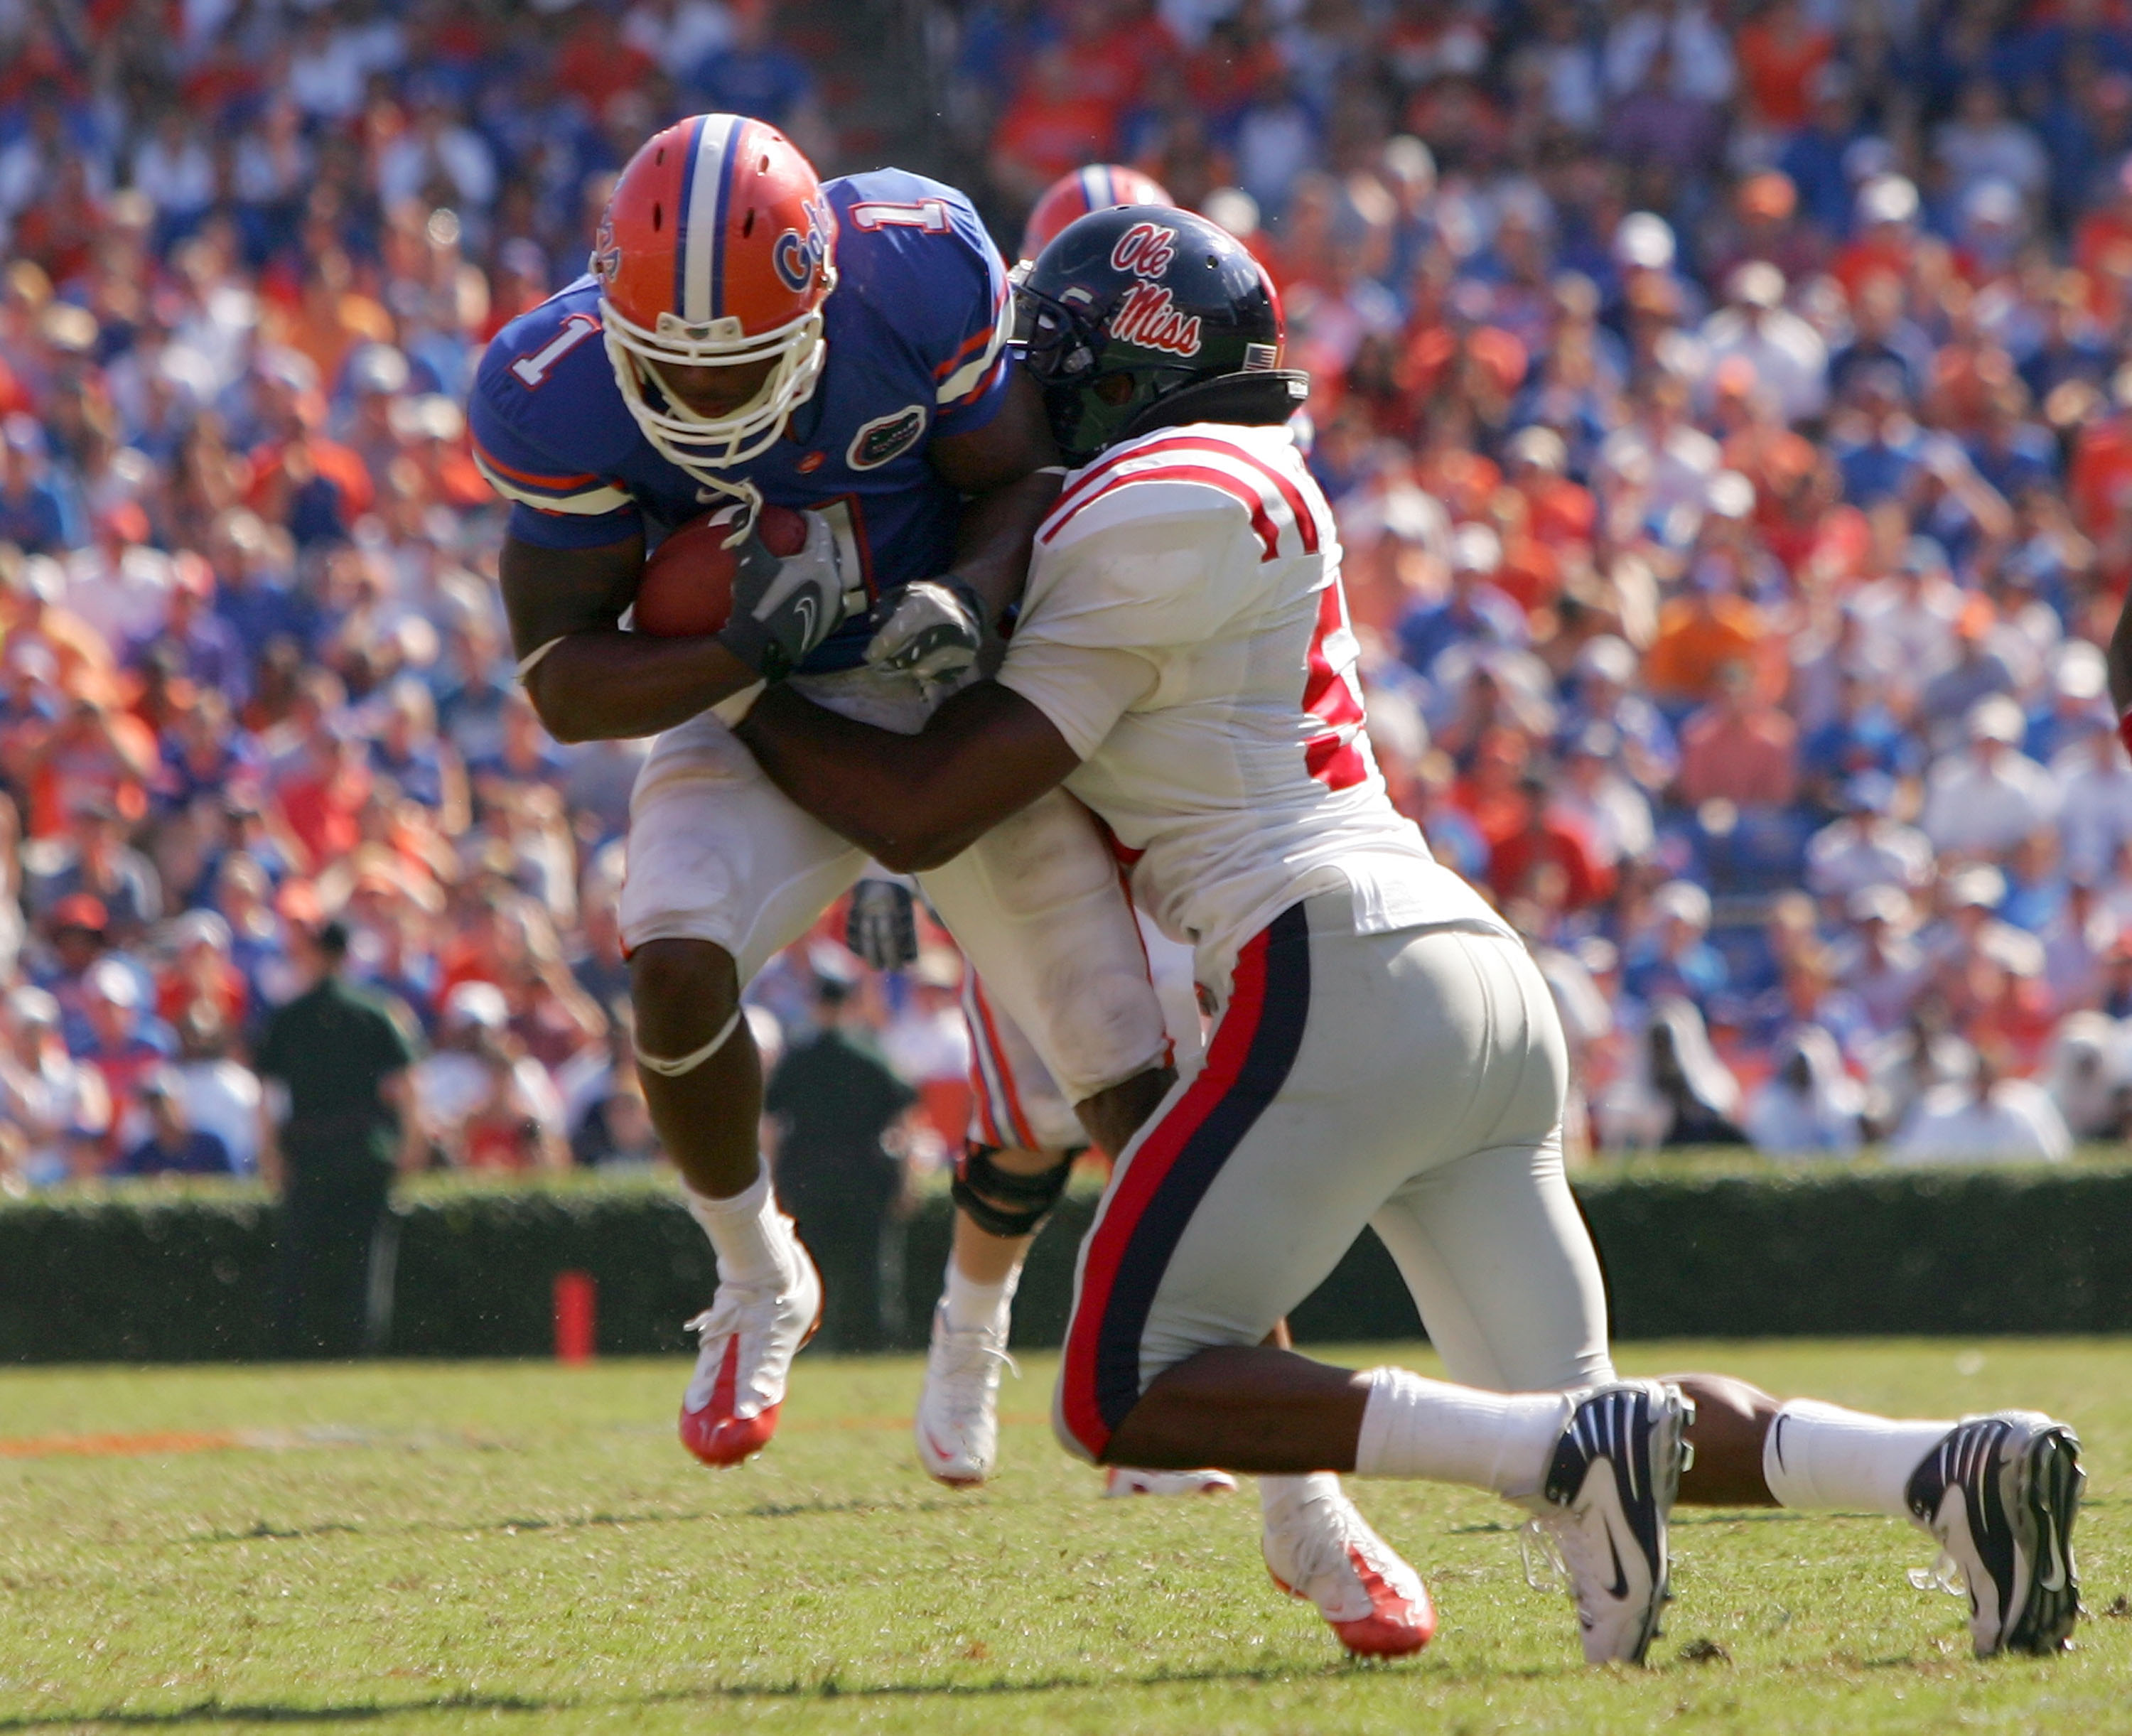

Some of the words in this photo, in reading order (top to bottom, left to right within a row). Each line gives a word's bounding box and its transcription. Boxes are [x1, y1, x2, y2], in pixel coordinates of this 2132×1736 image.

[849, 198, 952, 234] 1
[1111, 222, 1175, 279] Ole
[1110, 279, 1201, 357] Miss
[504, 313, 603, 392] 1
